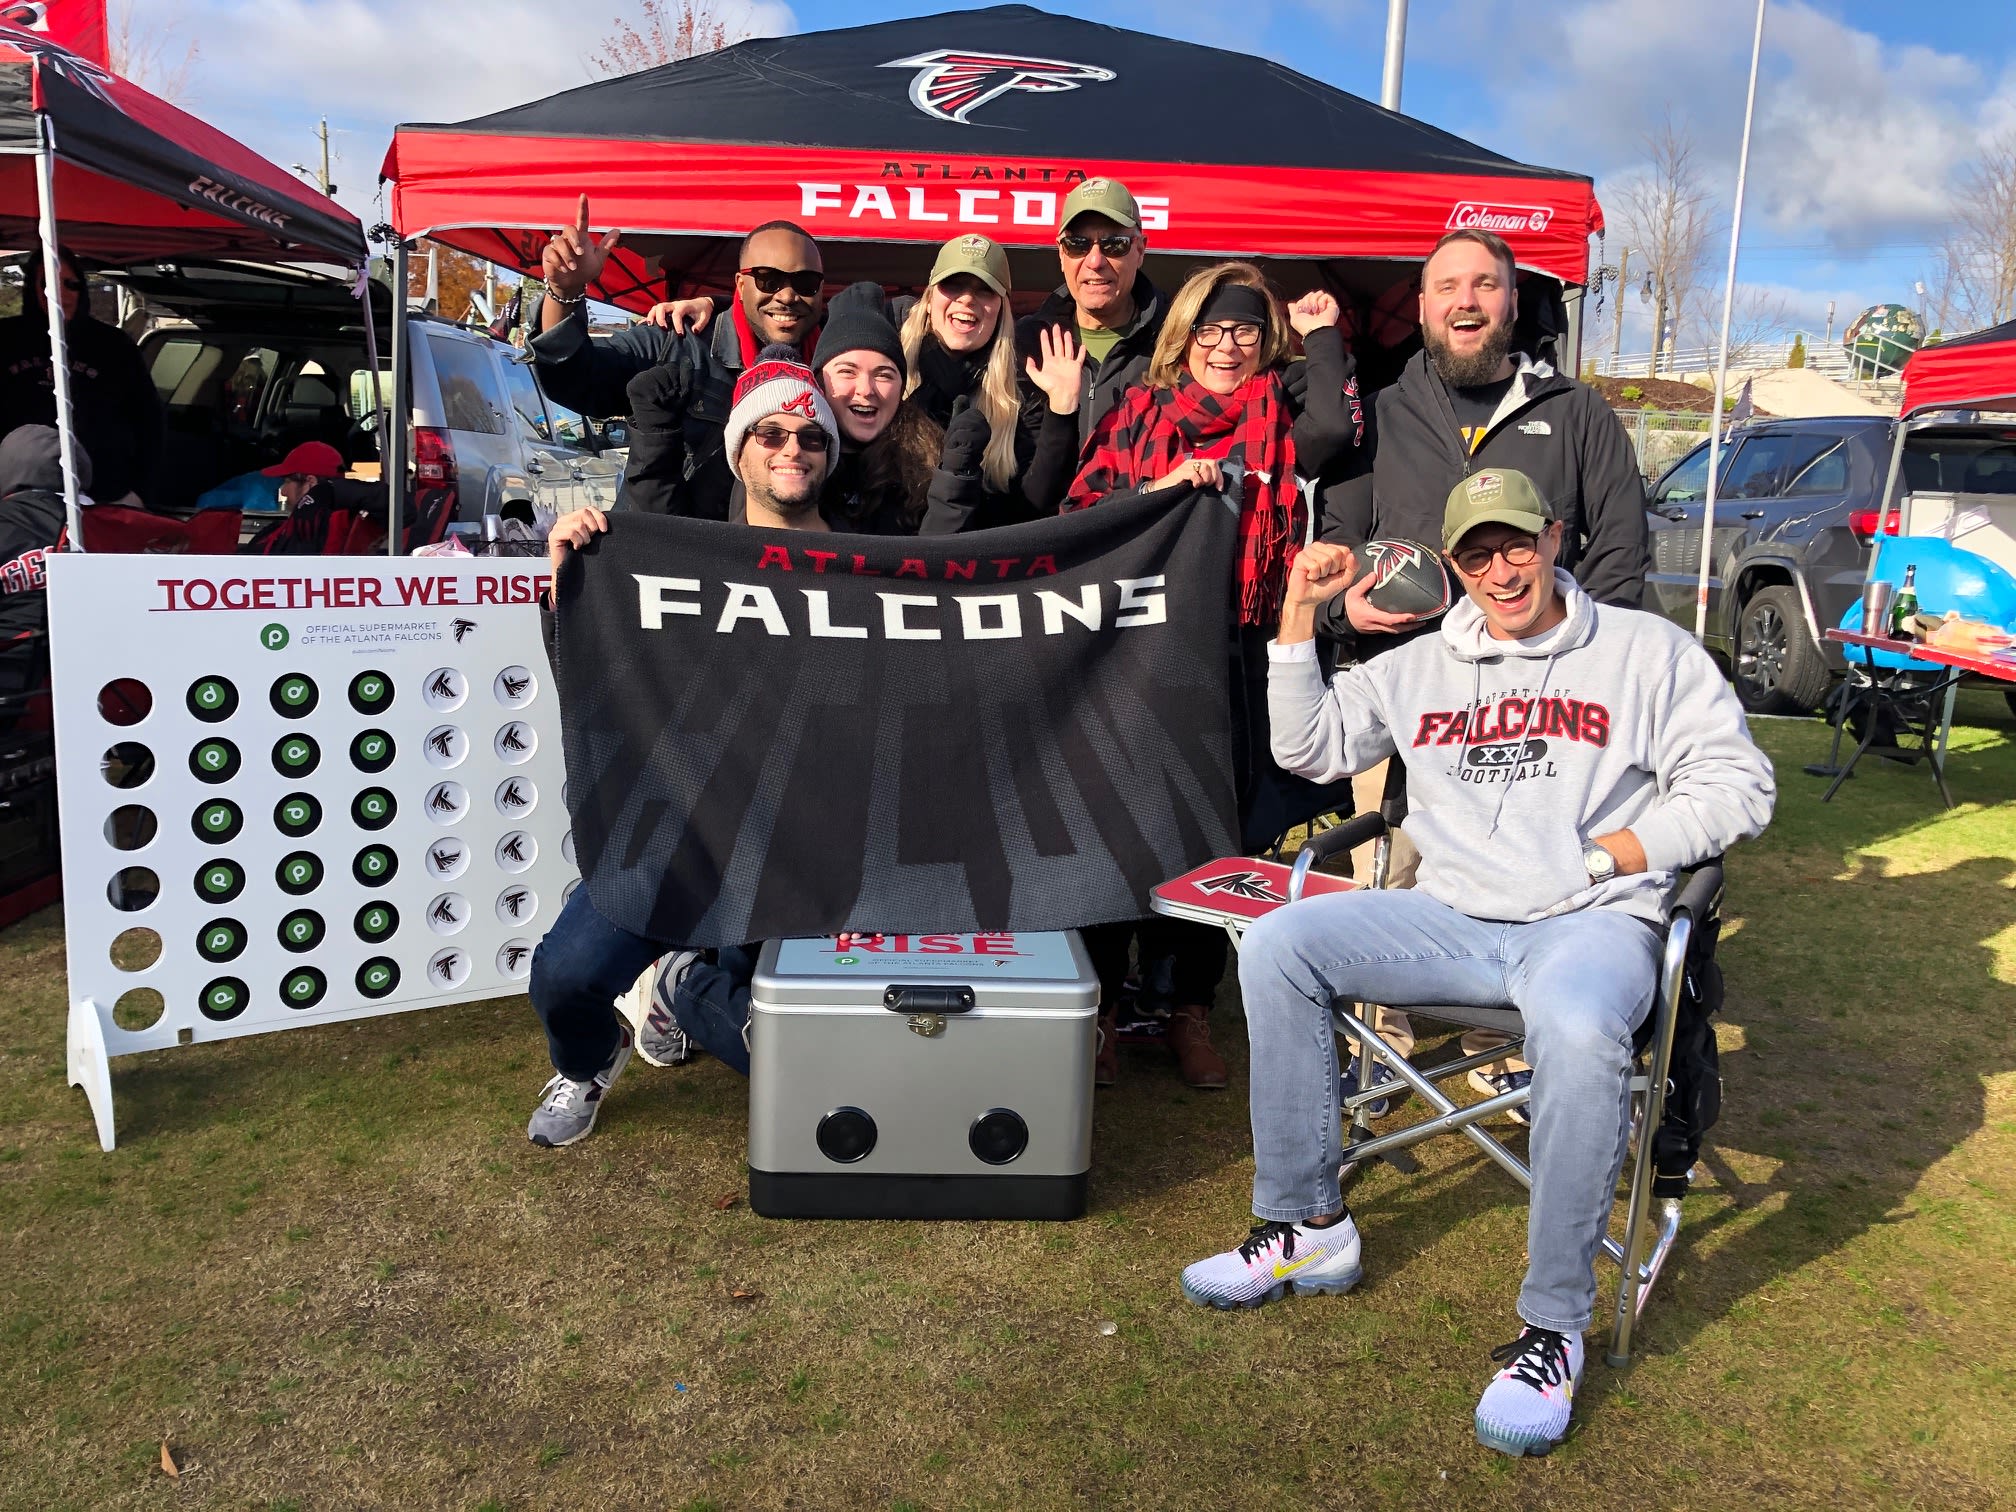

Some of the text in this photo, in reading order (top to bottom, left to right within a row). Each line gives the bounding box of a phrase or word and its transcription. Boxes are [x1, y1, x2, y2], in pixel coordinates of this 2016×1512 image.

[880, 161, 1088, 183] ATLANTA
[796, 182, 1170, 230] FALCOS
[1455, 205, 1528, 230] Coleman
[756, 544, 1059, 580] ATLANTA
[157, 577, 382, 611] TOGETHER
[393, 576, 458, 606] WE
[630, 574, 1167, 640] FALCONS
[301, 632, 442, 645] OF THE ATLANTA FALCONS
[306, 622, 437, 634] OFFICIAL SUPERMARKET
[1553, 689, 1571, 698] OF
[1412, 697, 1610, 749] FALCONS
[1477, 744, 1534, 764] XXL
[835, 934, 1019, 956] RISE
